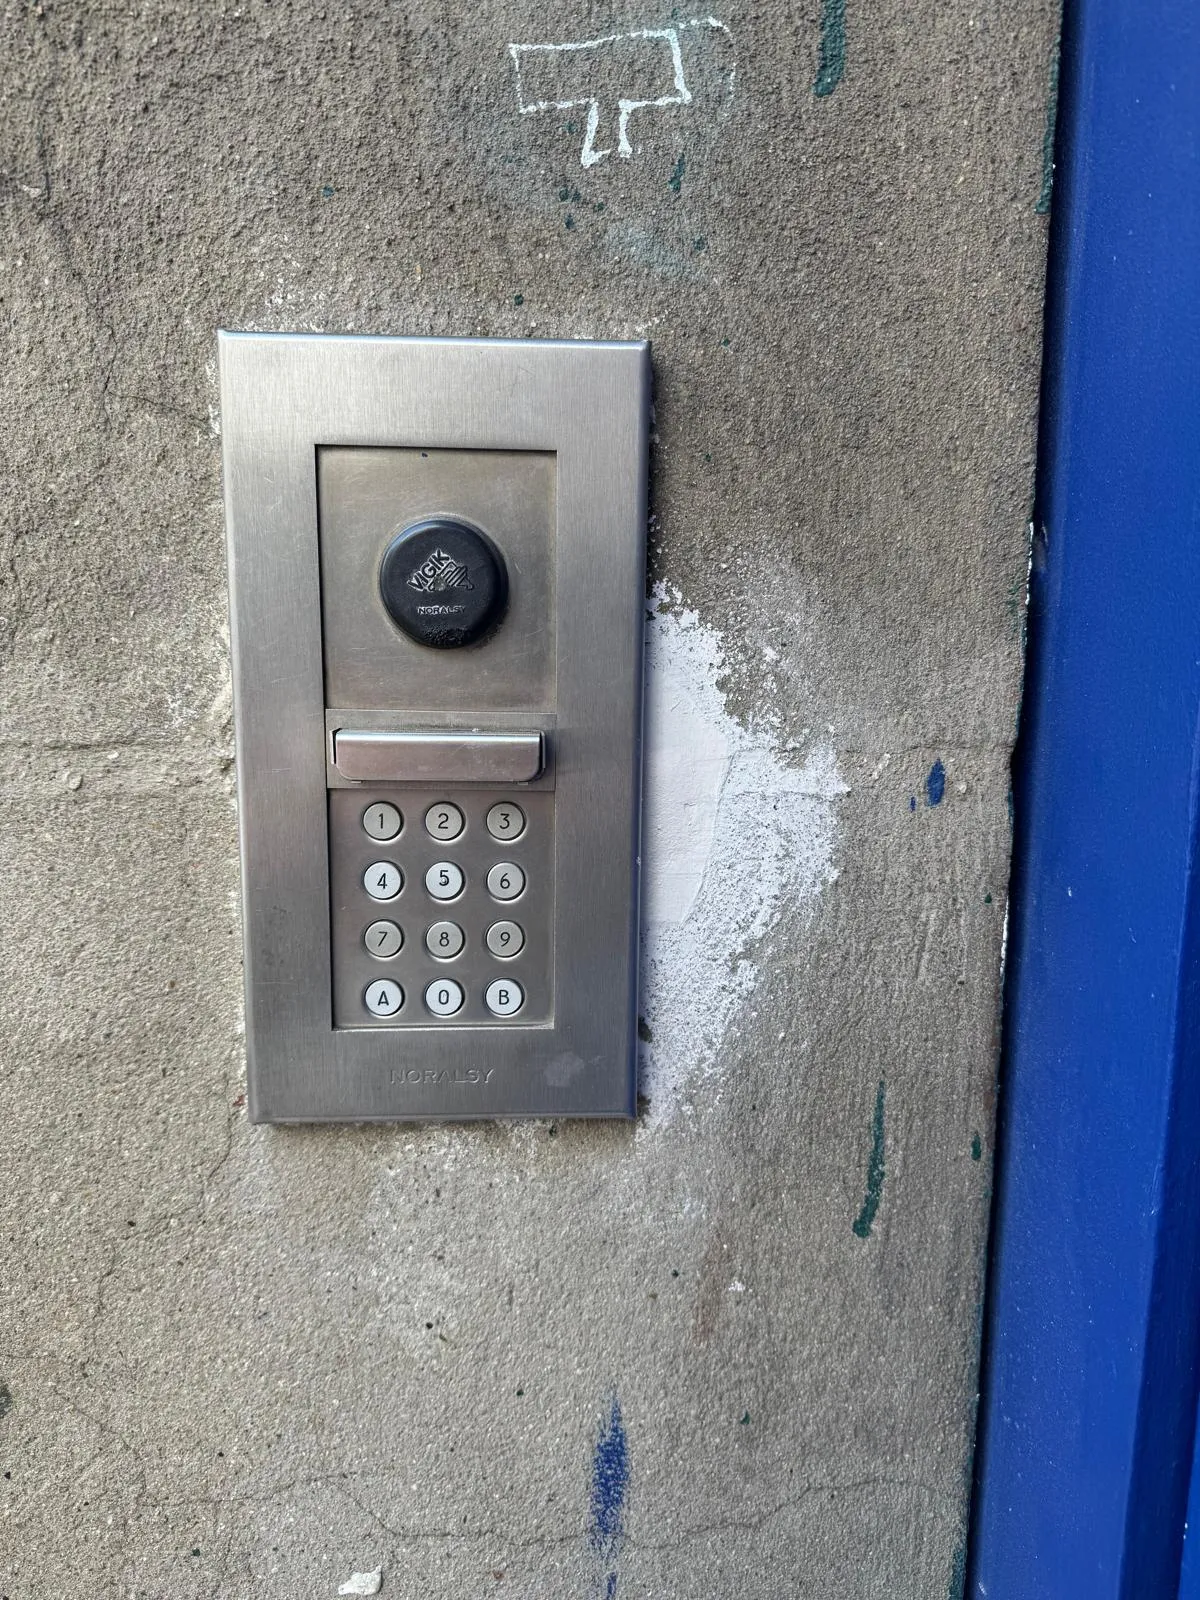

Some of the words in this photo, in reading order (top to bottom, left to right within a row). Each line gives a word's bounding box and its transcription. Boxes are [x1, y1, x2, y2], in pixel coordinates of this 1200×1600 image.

[407, 548, 451, 592] VIGIK
[417, 605, 466, 615] NORALSY
[437, 812, 449, 829] 2
[499, 813, 510, 829] 3
[377, 872, 388, 889] 4
[438, 870, 449, 886] 5
[499, 872, 510, 889] 6
[377, 931, 388, 947] 7
[438, 931, 449, 947] 8
[499, 931, 511, 947] 9
[377, 990, 389, 1006] A
[498, 989, 509, 1005] B
[390, 1068, 494, 1084] NORALSY
